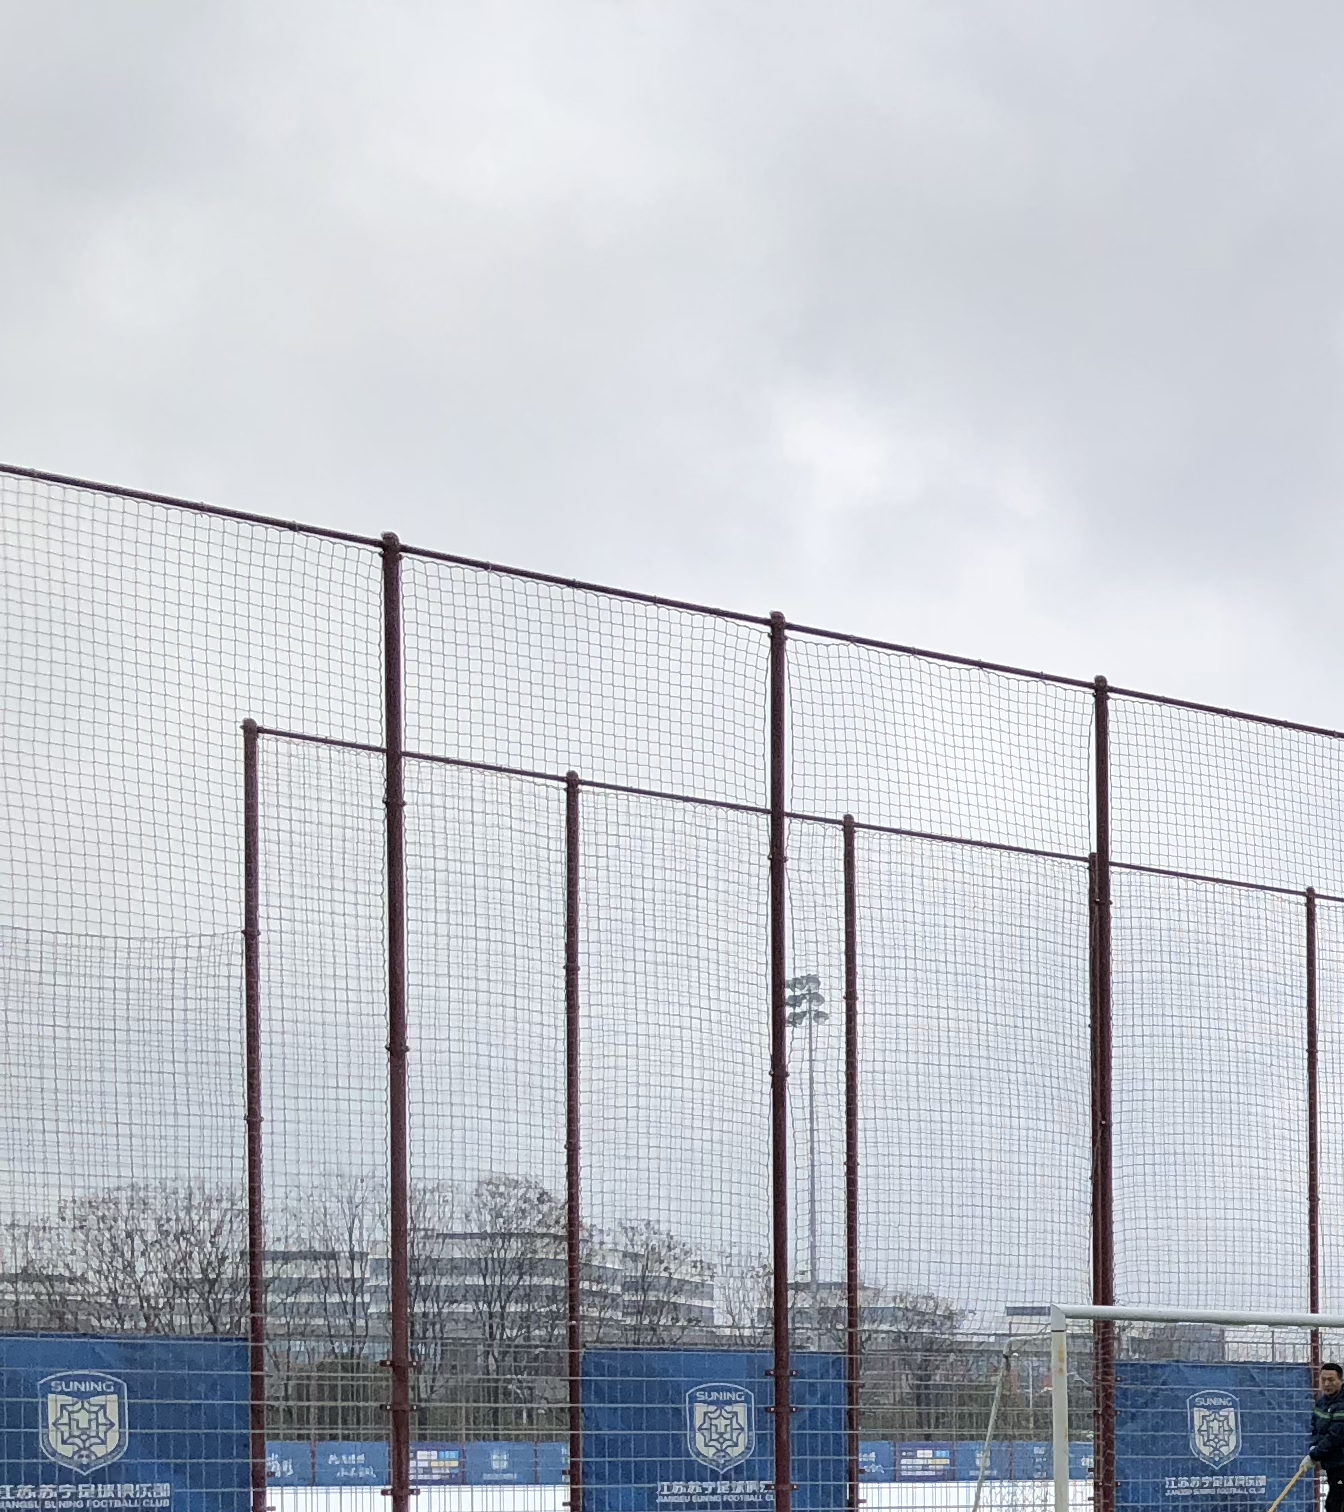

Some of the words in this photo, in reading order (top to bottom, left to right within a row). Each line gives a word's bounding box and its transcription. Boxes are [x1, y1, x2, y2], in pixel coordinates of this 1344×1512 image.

[51, 1380, 115, 1393] SUNING
[696, 1391, 745, 1401] SUNING
[1195, 1397, 1233, 1406] SUNING
[44, 1500, 84, 1509] SUNING
[86, 1499, 139, 1509] FOOTBALL
[142, 1499, 170, 1508] CLUB
